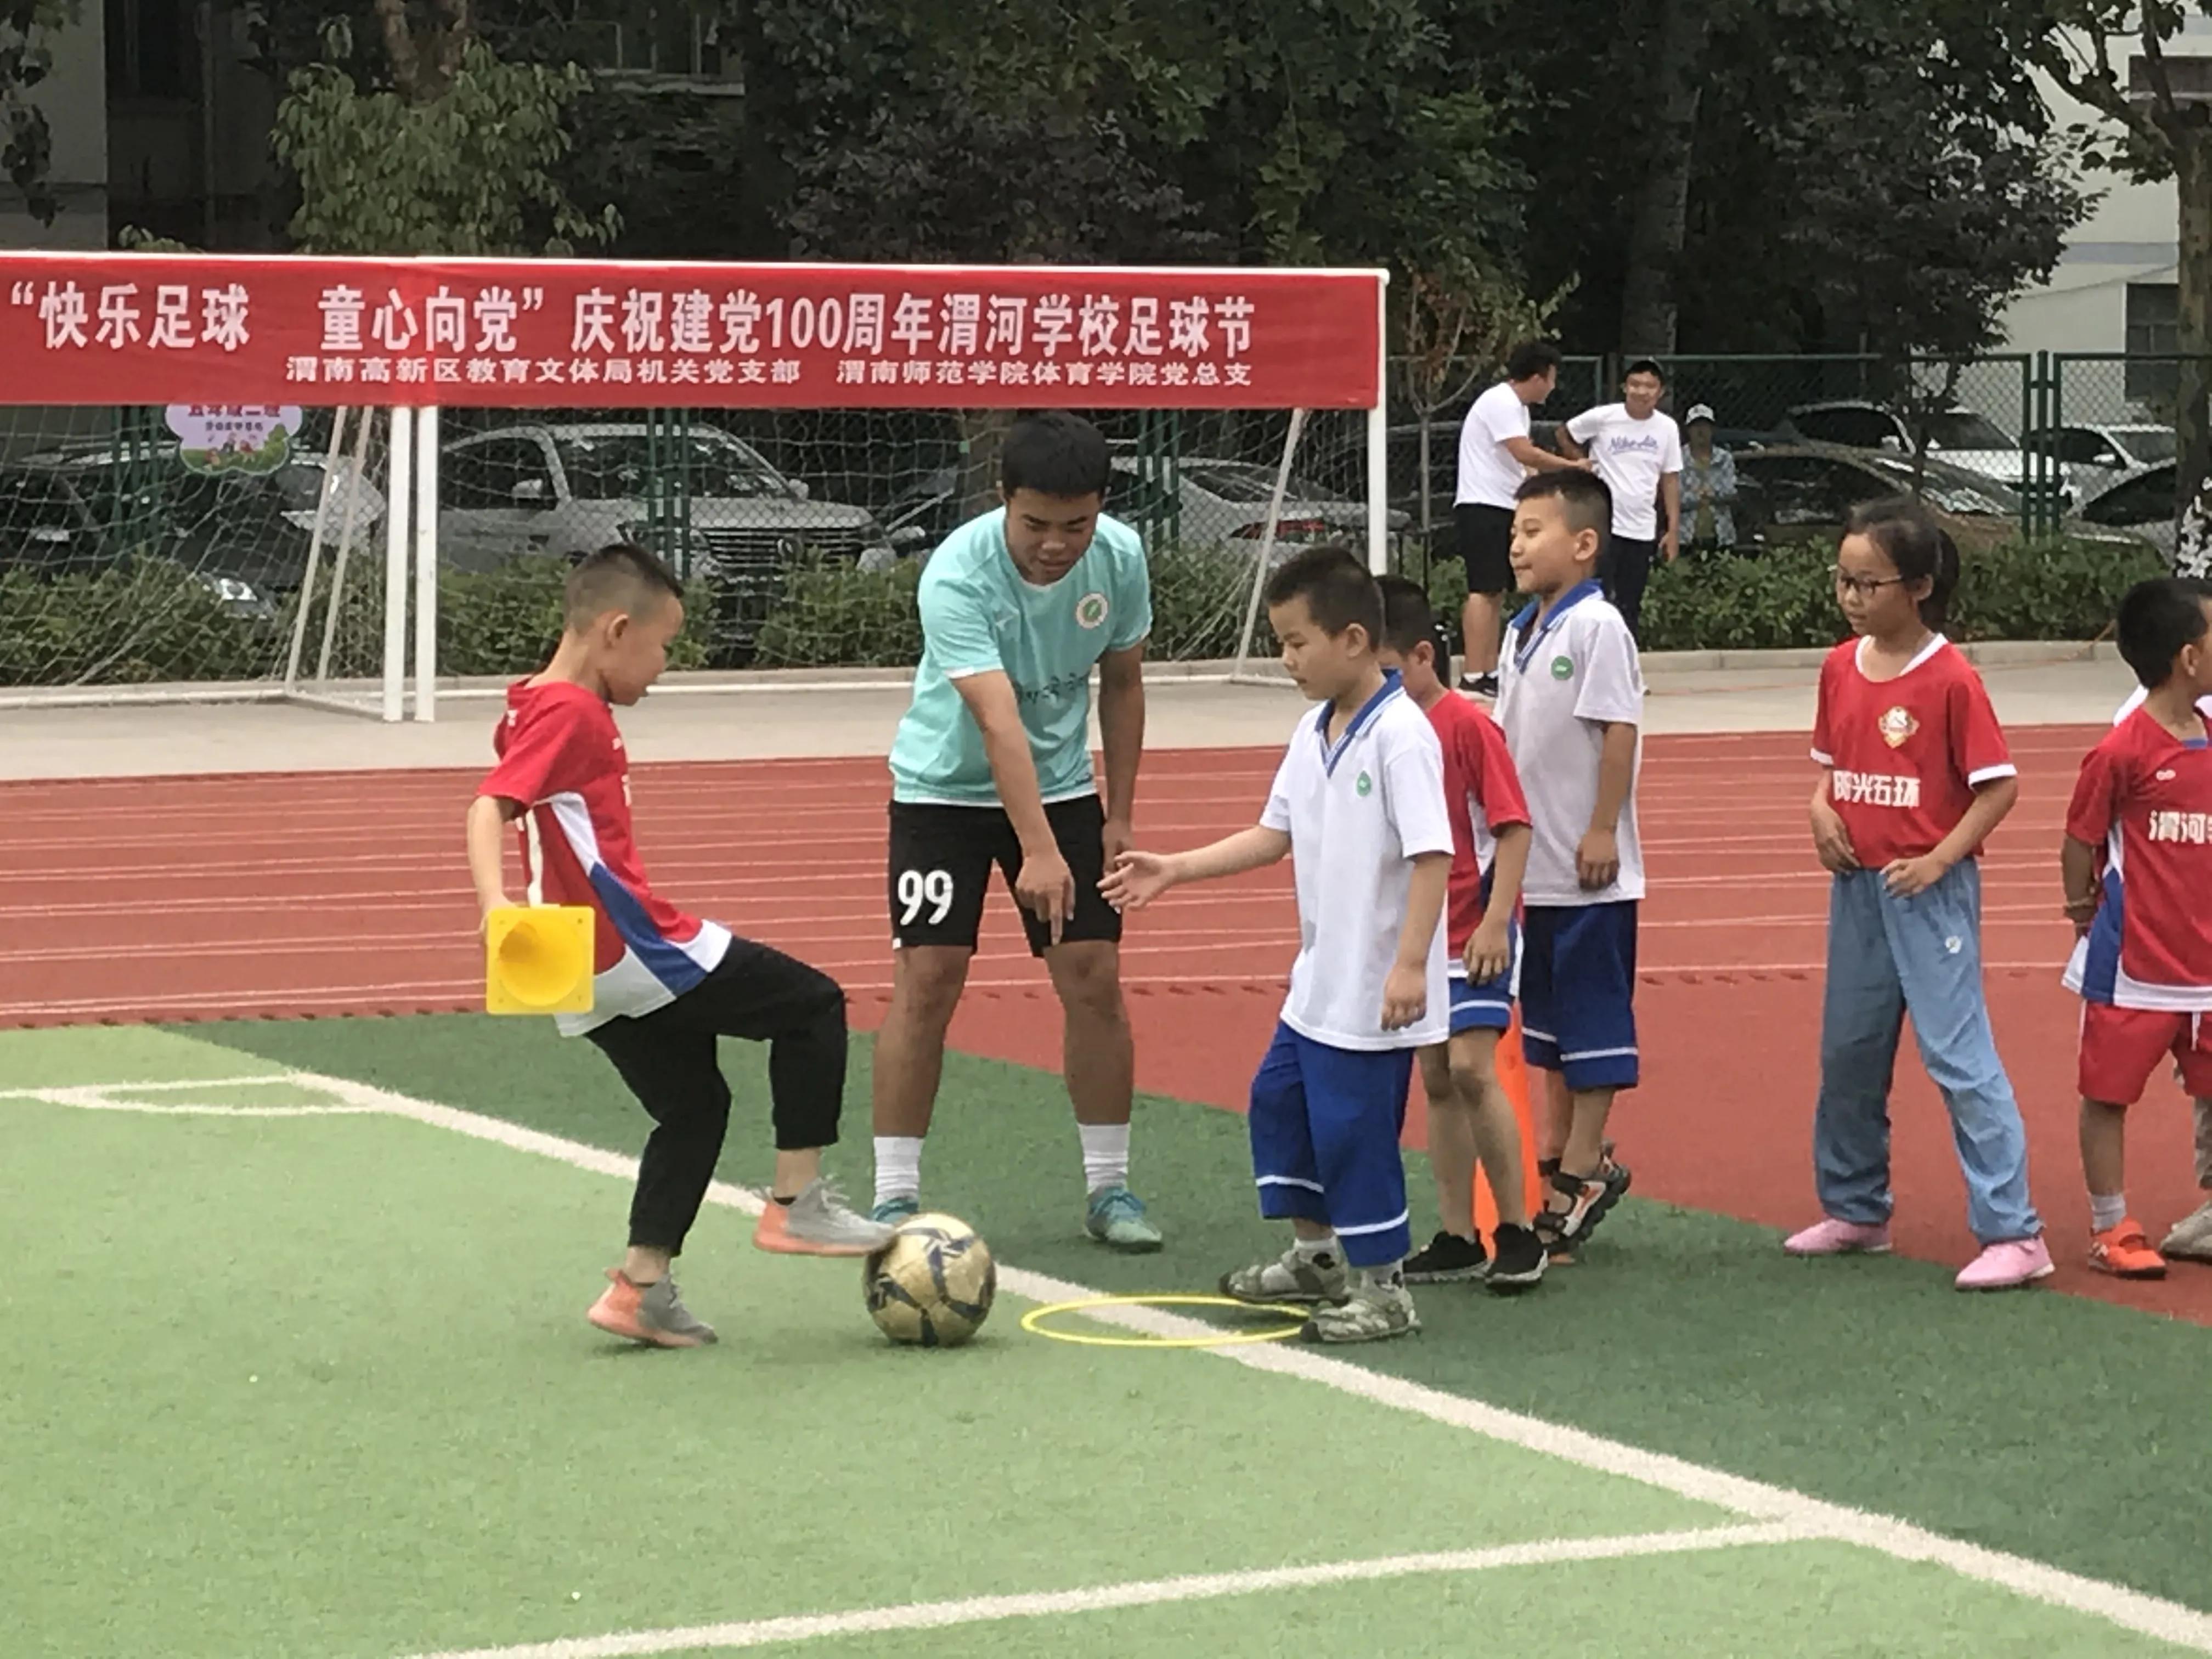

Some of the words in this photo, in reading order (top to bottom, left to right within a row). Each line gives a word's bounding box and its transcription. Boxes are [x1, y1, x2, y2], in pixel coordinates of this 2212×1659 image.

[570, 286, 1255, 359] 庆祝建党100周年渭河学校足球节
[285, 355, 801, 385] 渭南高新区教育文体局机关党支部
[836, 358, 1252, 387] 渭南师范学院体育学院党总支
[2148, 809, 2212, 845] 渭河
[898, 869, 953, 926] 99
